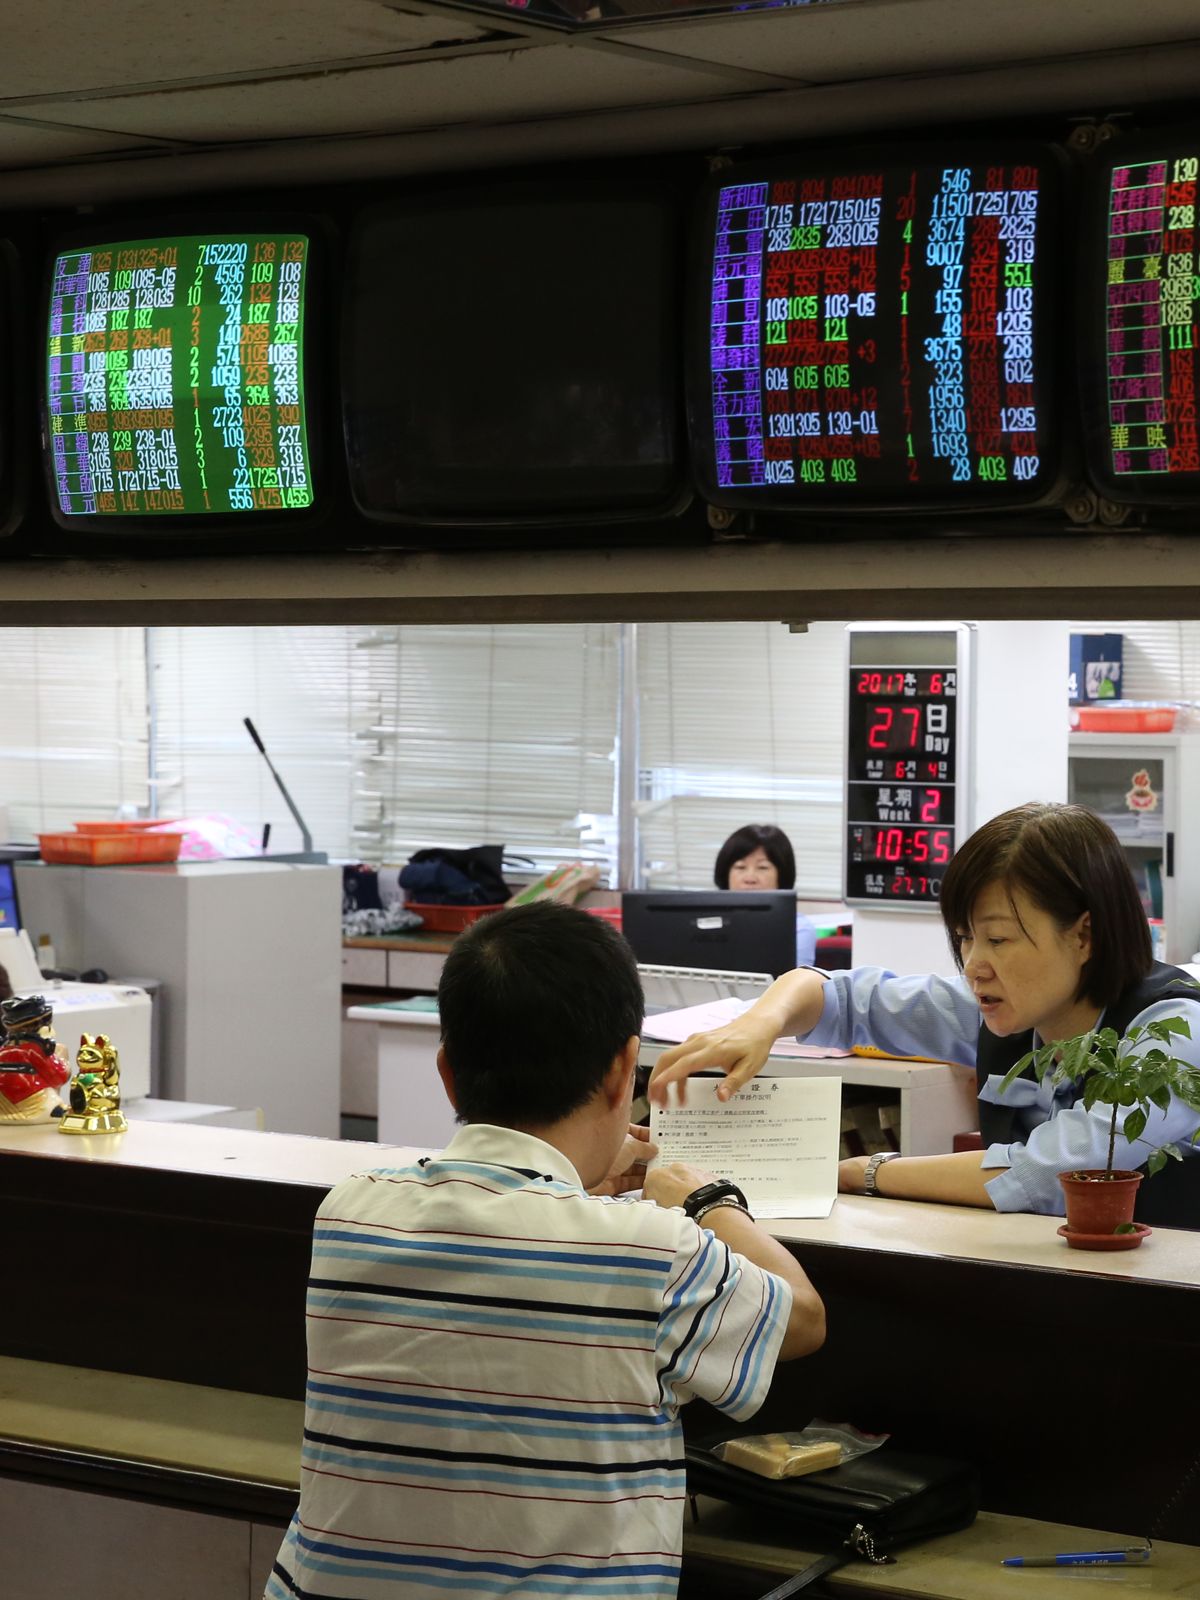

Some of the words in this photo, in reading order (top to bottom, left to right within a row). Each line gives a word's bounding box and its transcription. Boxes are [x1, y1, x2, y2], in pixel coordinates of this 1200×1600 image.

[941, 168, 971, 193] 546
[1173, 158, 1198, 183] 130
[764, 205, 793, 228] 1715
[1168, 205, 1194, 229] 238
[903, 220, 912, 243] 4
[928, 217, 964, 242] 3674
[998, 216, 1035, 240] 2825
[926, 241, 964, 267] 9007
[1005, 239, 1034, 263] 319
[1168, 252, 1192, 277] 636
[215, 263, 245, 284] 4596
[251, 263, 273, 283] 109
[279, 262, 301, 282] 108
[943, 265, 963, 289] 97
[1004, 263, 1033, 287] 551
[187, 286, 201, 306] 10
[220, 284, 243, 304] 262
[278, 282, 299, 302] 128
[901, 291, 908, 315] 1
[934, 289, 962, 314] 155
[1005, 288, 1033, 312] 103
[134, 309, 153, 329] 187
[225, 304, 241, 324] 24
[248, 303, 270, 324] 187
[276, 303, 298, 323] 186
[766, 320, 788, 344] 121
[825, 318, 848, 342] 121
[942, 312, 962, 336] 48
[996, 311, 1032, 335] 1205
[274, 324, 297, 344] 267
[1169, 324, 1193, 350] 111
[924, 336, 962, 361] 3675
[1004, 335, 1032, 360] 268
[766, 367, 789, 390] 604
[794, 366, 818, 389] 605
[824, 364, 849, 388] 605
[935, 361, 963, 385] 323
[1005, 359, 1033, 383] 602
[246, 386, 270, 405] 364
[274, 385, 299, 405] 363
[929, 385, 965, 409] 1956
[212, 407, 242, 427] 2723
[1000, 407, 1036, 432] 1295
[113, 431, 132, 450] 239
[222, 427, 244, 447] 109
[278, 427, 301, 446] 237
[932, 433, 968, 457] 1693
[237, 448, 247, 468] 6
[280, 447, 304, 466] 318
[765, 460, 795, 484] 4025
[800, 459, 825, 482] 403
[832, 458, 857, 482] 403
[951, 456, 971, 480] 28
[978, 456, 1006, 480] 403
[1013, 456, 1039, 480] 402
[930, 673, 942, 694] 6
[868, 707, 920, 748] 27
[926, 704, 948, 733] 日
[925, 735, 950, 754] Day
[878, 808, 911, 821] Week
[921, 789, 940, 822] 2
[875, 829, 949, 862] 10:55
